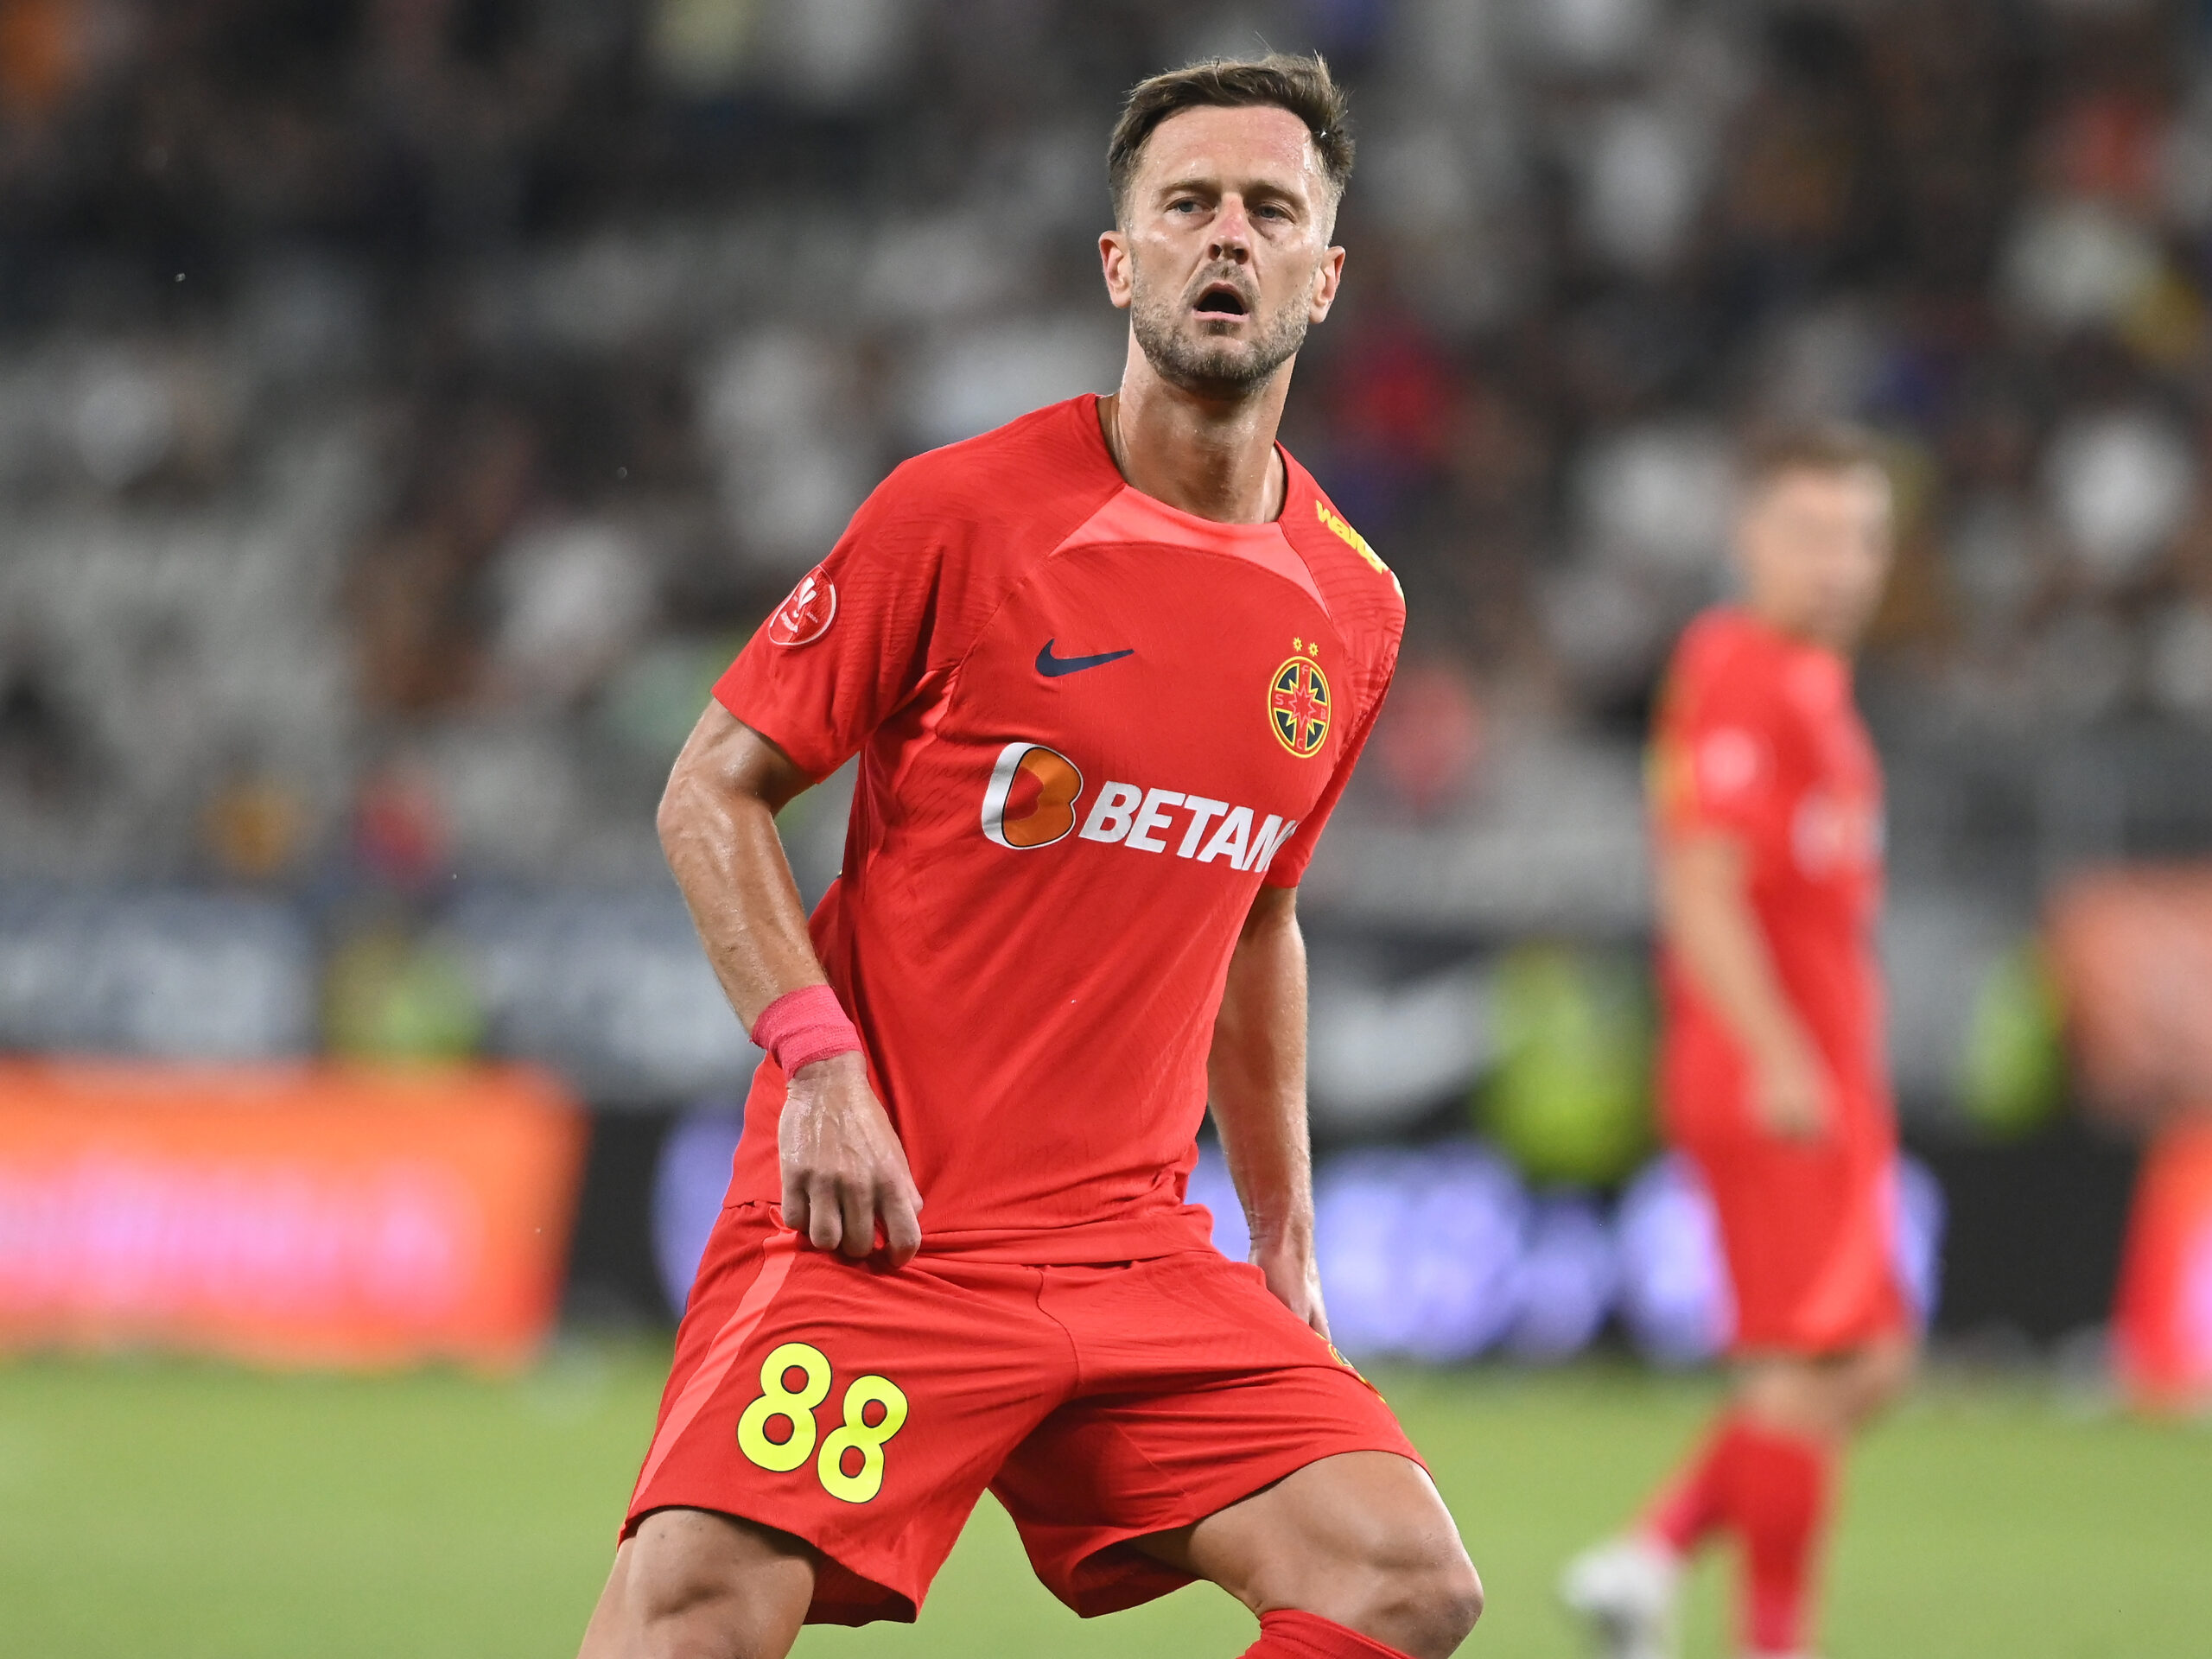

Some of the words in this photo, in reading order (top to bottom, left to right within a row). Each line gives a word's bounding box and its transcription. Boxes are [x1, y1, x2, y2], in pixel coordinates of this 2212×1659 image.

[1300, 664, 1310, 676] F
[1274, 694, 1285, 706] S
[1296, 738, 1305, 750] C
[1077, 780, 1300, 874] BETAN
[736, 1341, 909, 1504] 88
